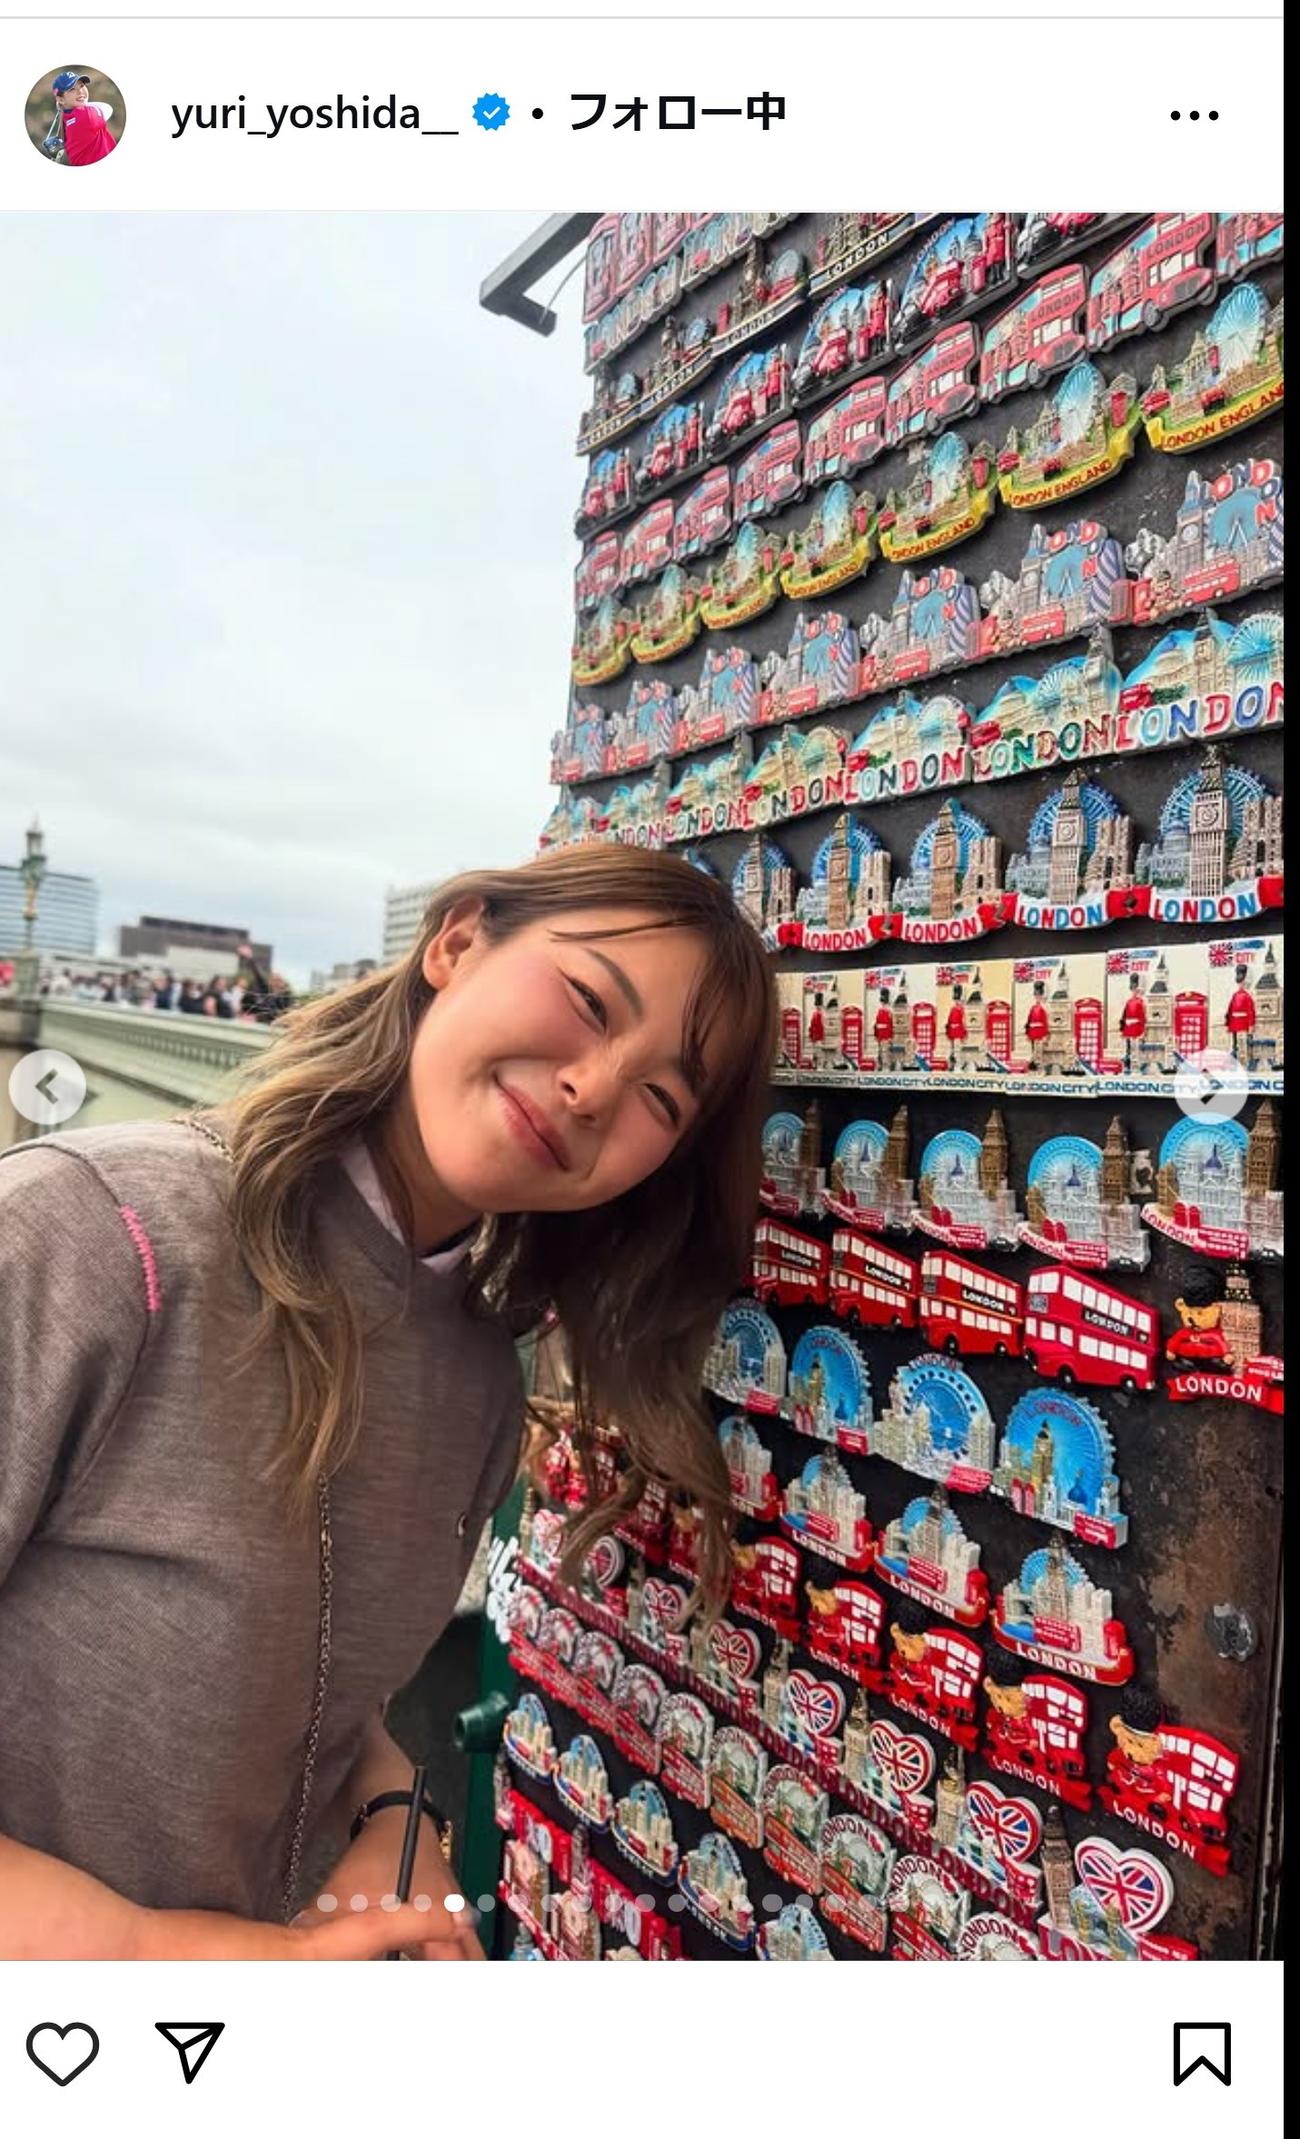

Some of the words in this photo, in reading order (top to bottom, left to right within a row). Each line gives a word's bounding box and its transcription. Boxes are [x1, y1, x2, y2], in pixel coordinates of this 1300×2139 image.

[826, 232, 889, 280] LONDON
[1147, 222, 1205, 257] LONDON
[1031, 293, 1080, 320] LONDON
[1160, 422, 1214, 449] LONDON
[1054, 460, 1112, 496] ENGLAND
[972, 714, 1111, 781] LONDON
[845, 747, 968, 806] LONDON
[742, 768, 846, 831] LONDON
[663, 798, 743, 843] LONDON
[1018, 902, 1102, 929] LONDON
[1154, 892, 1258, 920] LONDON
[804, 927, 867, 951] LONDON
[904, 917, 978, 943] LONDON
[857, 1076, 901, 1086] LONDON
[902, 1077, 926, 1087] CITY
[927, 1077, 975, 1088] LONDON
[976, 1079, 1004, 1089] CITY
[1097, 1082, 1160, 1093] LONDON
[866, 1264, 903, 1285] LONDON
[962, 1289, 1005, 1312] LONDON
[1085, 1311, 1130, 1336] LONDON
[1175, 1377, 1262, 1400] LONDON
[792, 1530, 847, 1567] LONDON
[889, 1574, 955, 1619] LONDON
[809, 1647, 860, 1682] LONDON
[1017, 1641, 1097, 1681] LONDON
[891, 1692, 950, 1736] LONDON
[993, 1755, 1061, 1797] LONDON
[1112, 1801, 1197, 1859] LONDON
